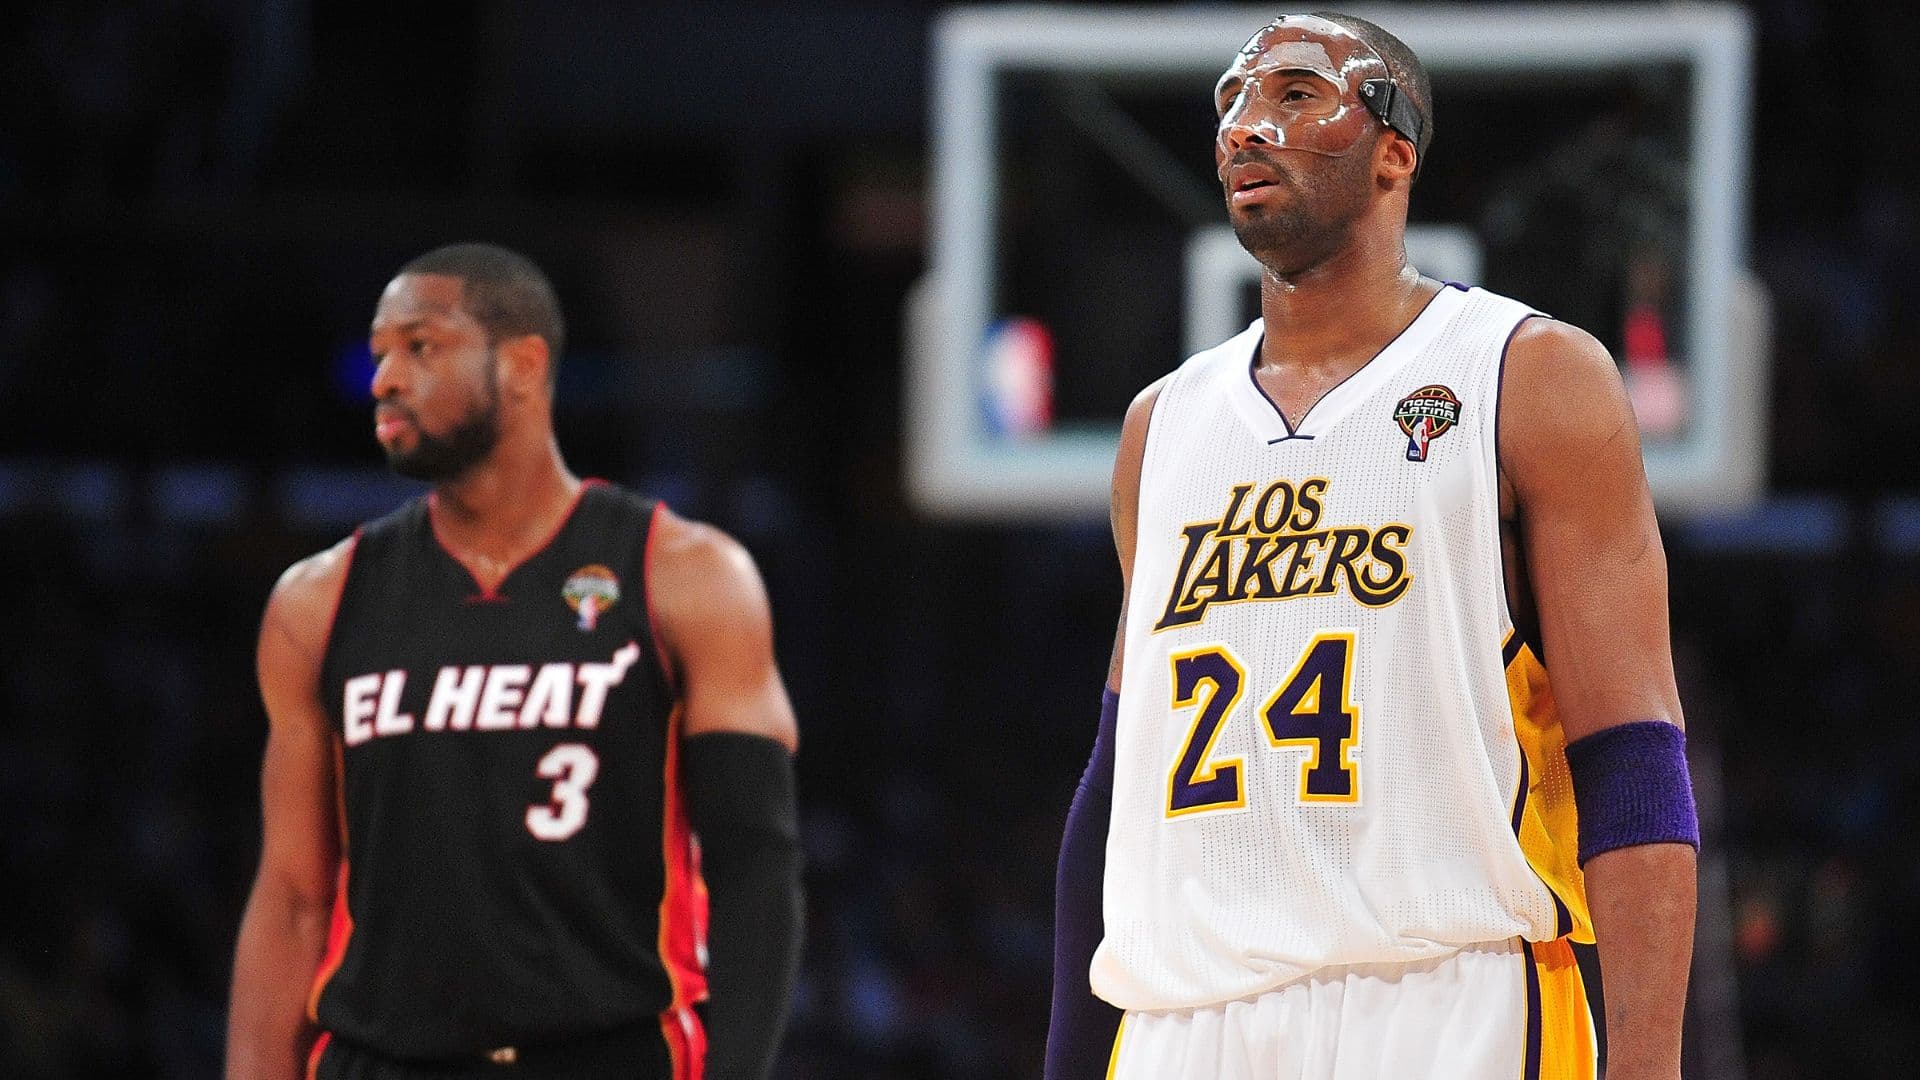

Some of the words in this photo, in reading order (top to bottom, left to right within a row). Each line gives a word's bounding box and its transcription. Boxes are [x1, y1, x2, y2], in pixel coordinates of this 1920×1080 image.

[1398, 406, 1455, 420] LATINA
[1402, 398, 1456, 411] NOCHE
[1216, 477, 1331, 539] LOS
[1152, 522, 1414, 634] LAKERS
[344, 668, 415, 747] EL
[423, 640, 641, 731] HEAT
[1165, 631, 1360, 820] 24
[525, 743, 599, 842] 3
